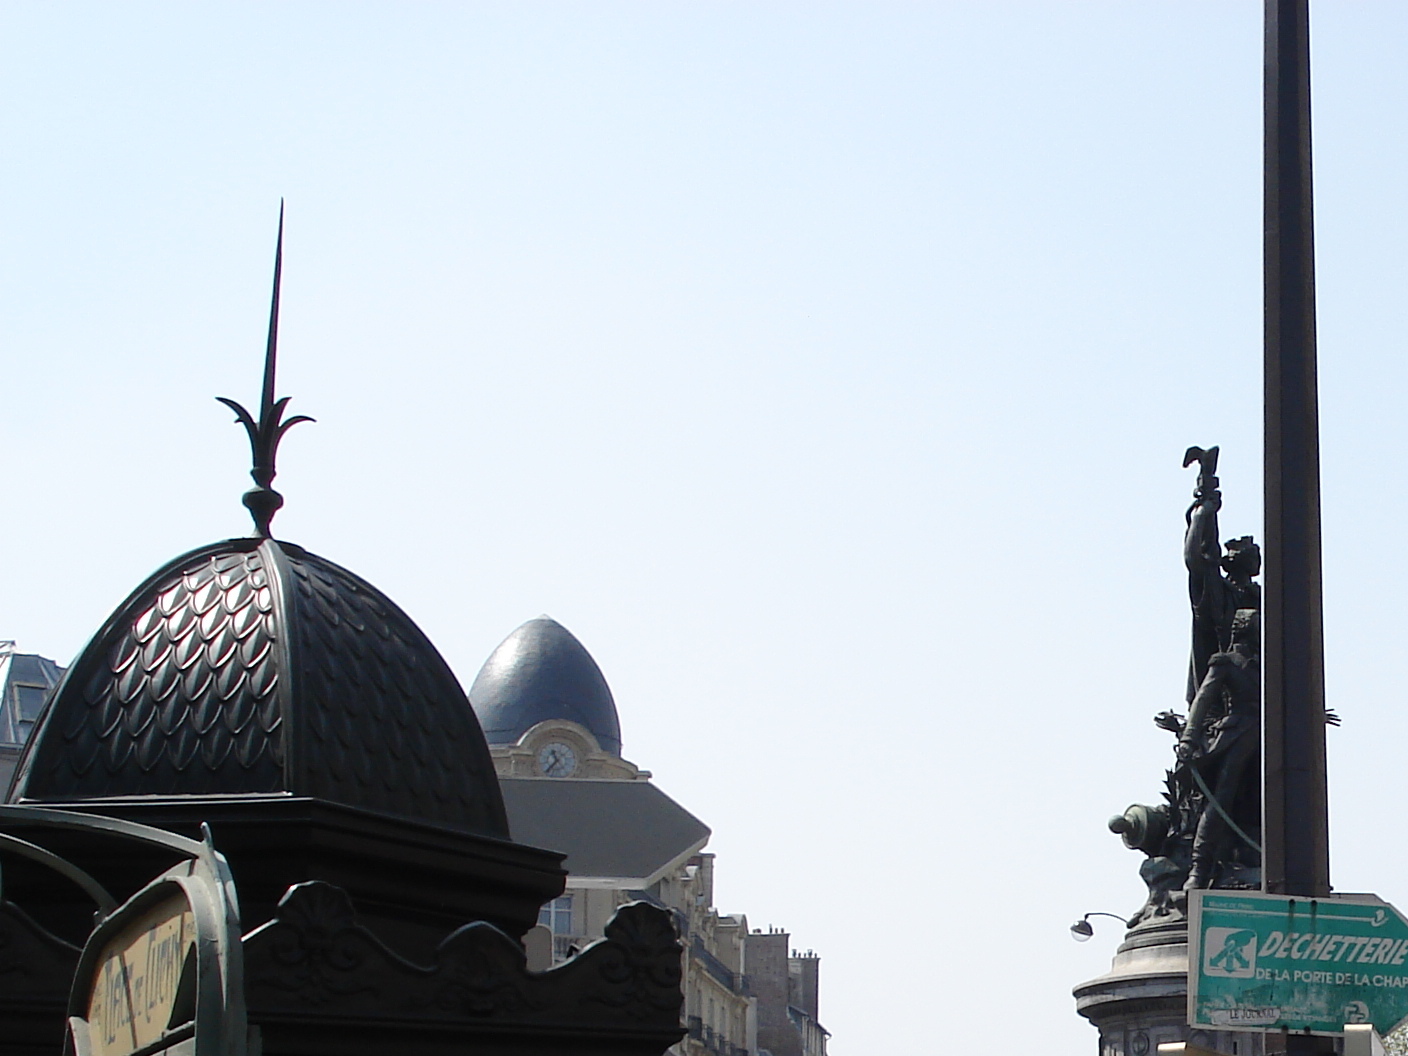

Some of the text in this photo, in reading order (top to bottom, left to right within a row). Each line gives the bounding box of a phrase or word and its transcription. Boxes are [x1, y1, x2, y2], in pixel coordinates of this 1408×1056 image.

[1255, 967, 1273, 981] DE
[1274, 968, 1291, 982] LA
[1293, 969, 1334, 985] PORTE
[1335, 972, 1353, 985] DE
[1354, 973, 1371, 986] LA
